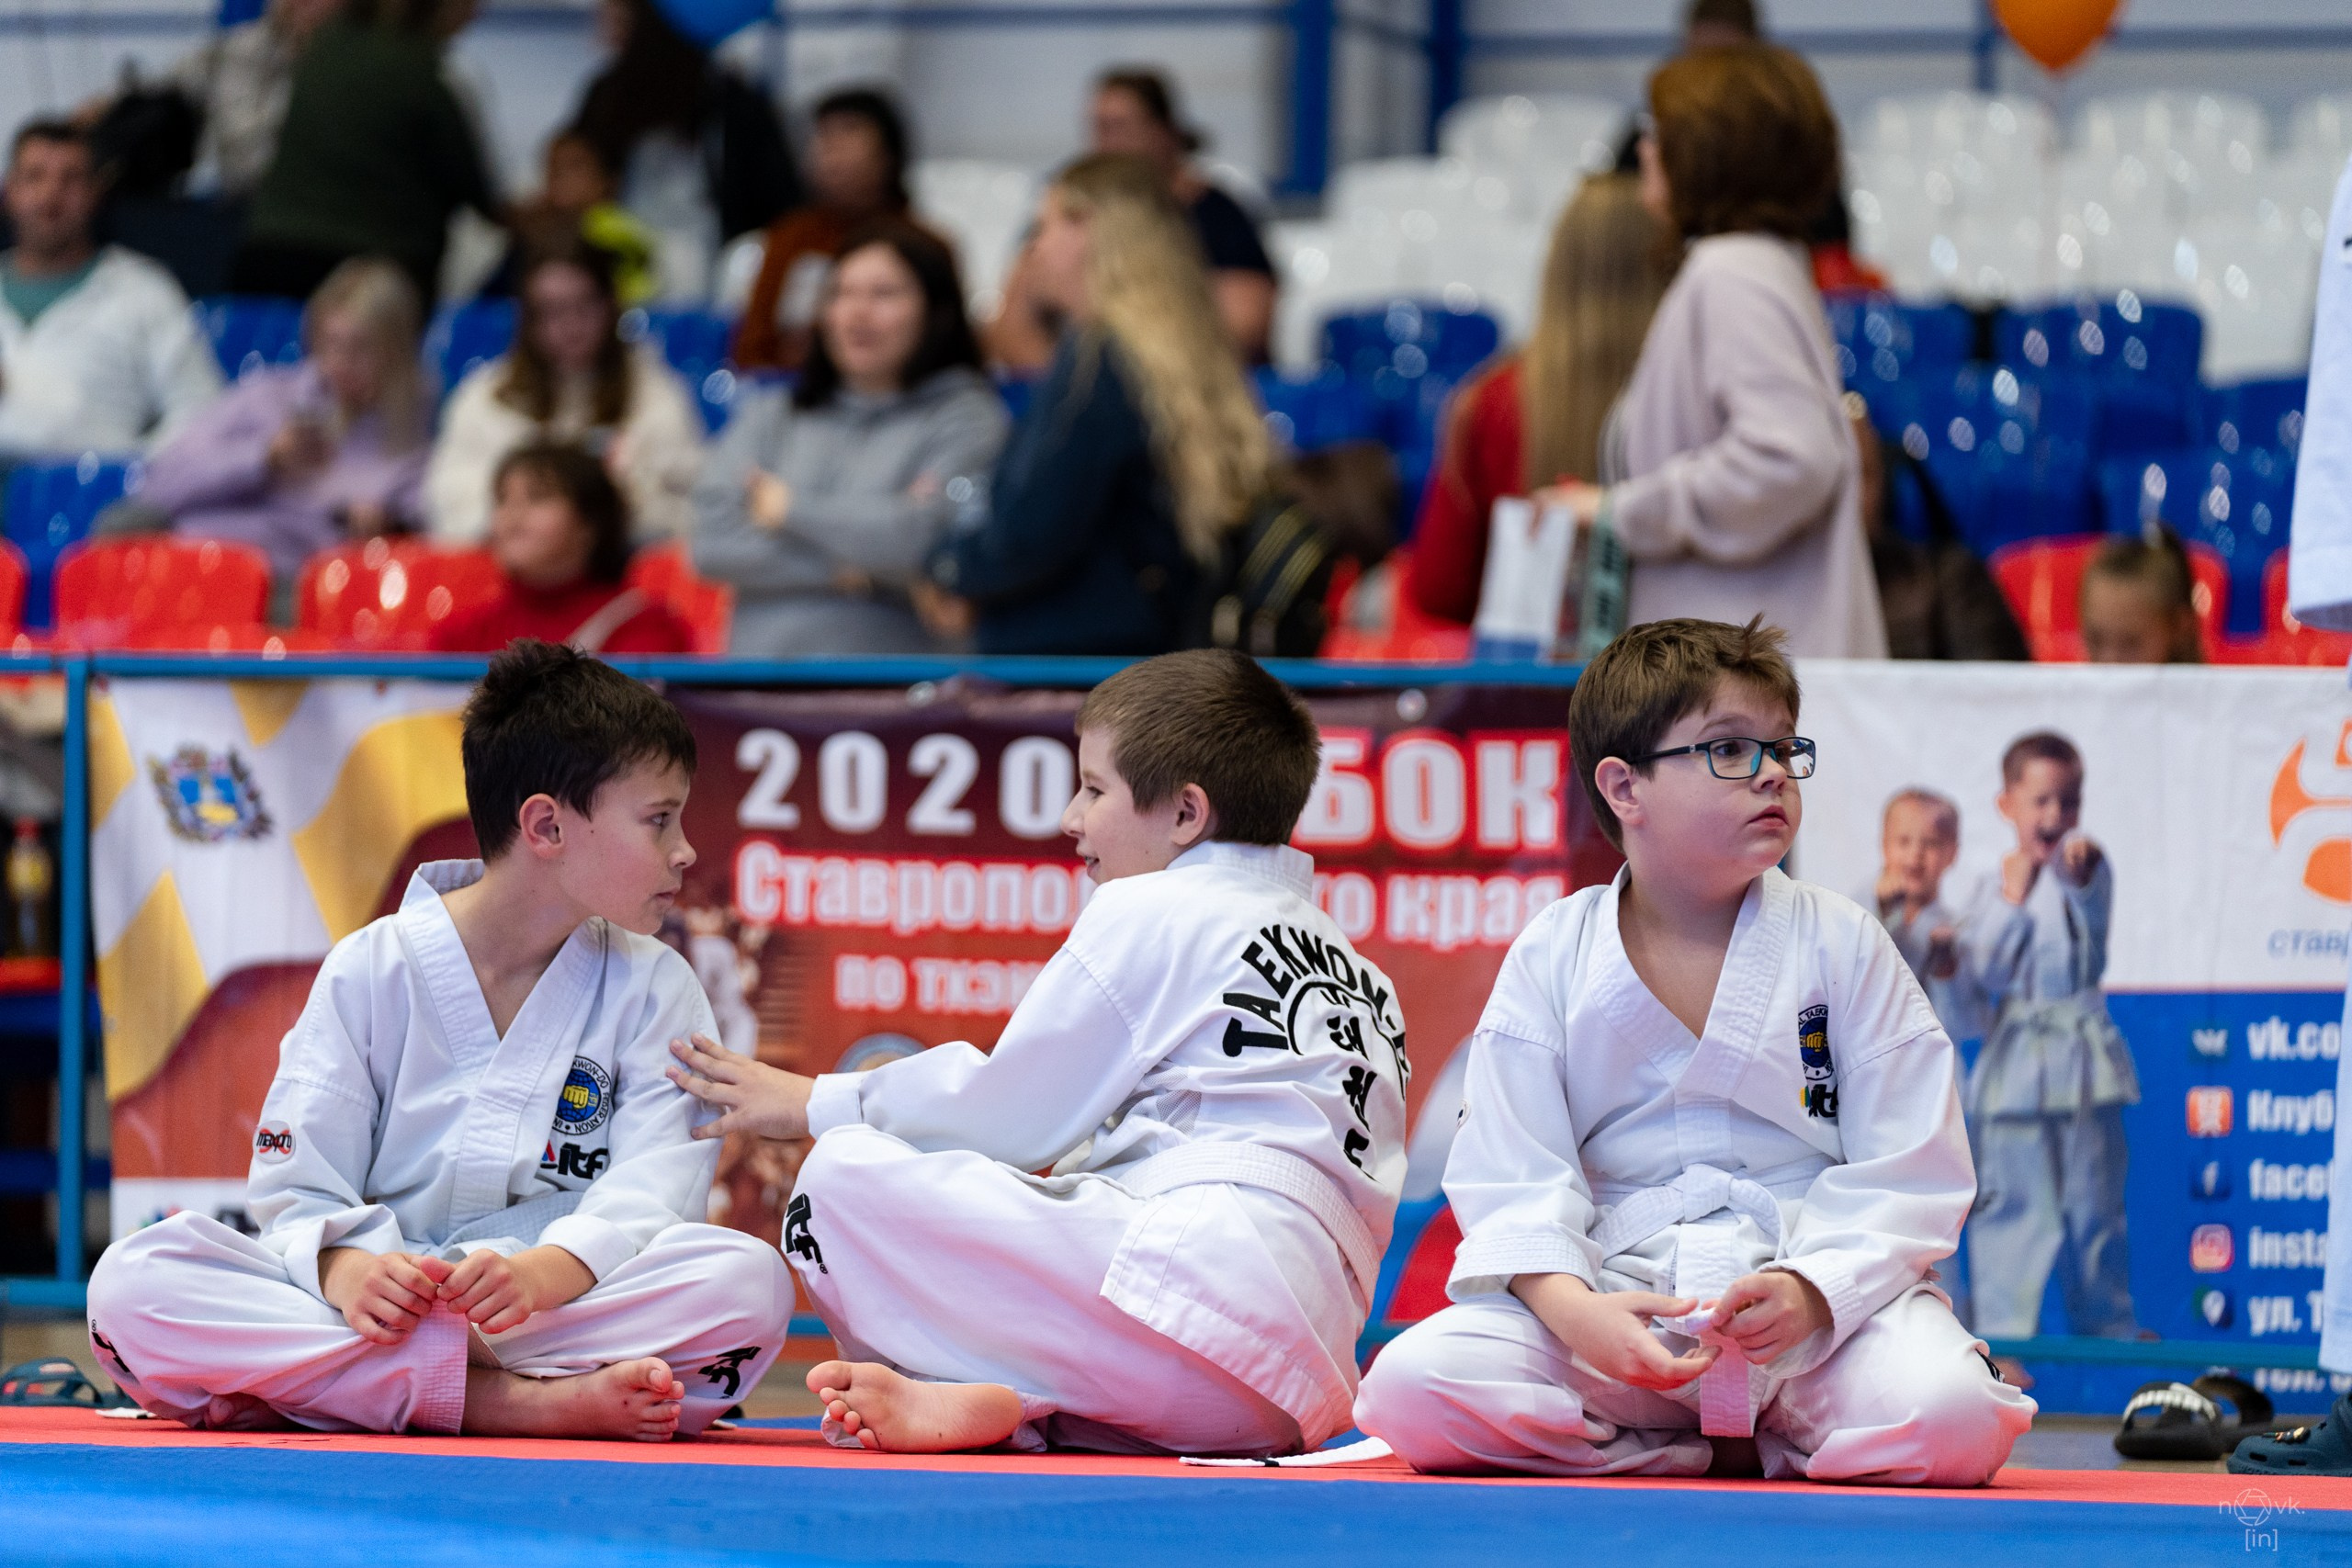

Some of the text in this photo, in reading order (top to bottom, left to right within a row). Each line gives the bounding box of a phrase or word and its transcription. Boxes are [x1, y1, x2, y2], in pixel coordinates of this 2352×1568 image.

[736, 729, 1076, 838] 2020
[1294, 736, 1560, 849] БОК
[2246, 1015, 2341, 1061] vk.co
